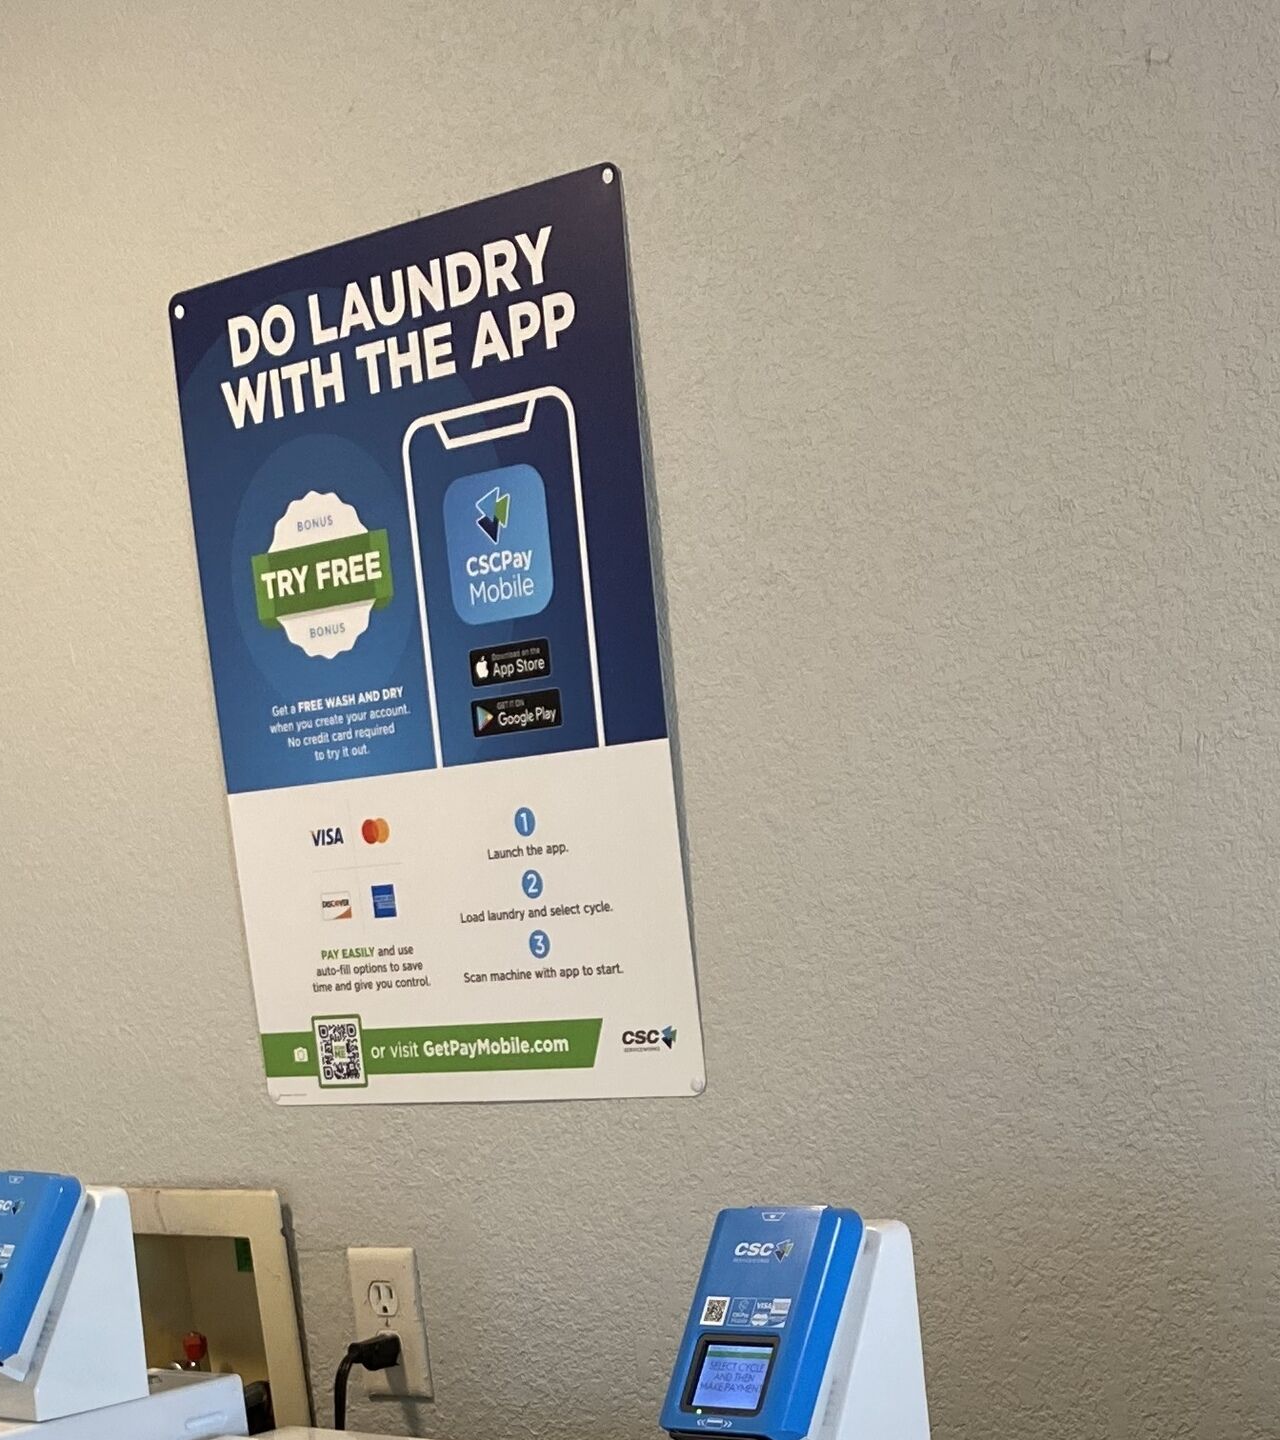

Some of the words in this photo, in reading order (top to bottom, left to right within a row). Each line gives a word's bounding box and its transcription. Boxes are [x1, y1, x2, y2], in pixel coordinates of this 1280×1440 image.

[227, 303, 296, 367] DO
[307, 225, 553, 346] LAUNDRY
[220, 352, 345, 430] WITH
[356, 321, 456, 394] THE
[471, 291, 575, 368] APP
[297, 515, 333, 532] BONUS
[466, 549, 533, 577] CSCPay
[260, 565, 308, 599] TRY
[316, 551, 382, 590] FREE
[469, 574, 535, 606] Mobile
[309, 622, 346, 638] BONUS
[493, 662, 515, 678] App
[516, 658, 545, 673] Store
[272, 705, 288, 717] Get
[298, 699, 323, 713] FREE
[324, 694, 356, 709] WASH
[358, 690, 380, 704] AND
[382, 686, 404, 700] DRY
[269, 722, 294, 734] when
[296, 719, 312, 732] you
[315, 714, 344, 728] create
[346, 711, 367, 725] your
[369, 704, 411, 719] account.
[498, 708, 534, 726] Google
[535, 706, 557, 722] Play
[287, 736, 301, 748] No
[303, 732, 330, 746] credit
[332, 728, 352, 741] card
[354, 722, 395, 739] required
[314, 750, 325, 760] to
[326, 748, 340, 760] try
[342, 746, 349, 757] it
[351, 744, 370, 756] out.
[520, 812, 528, 832] 1
[311, 827, 344, 847] VISA
[487, 846, 524, 860] Launch
[526, 844, 543, 856] the
[546, 843, 569, 855] app.
[526, 873, 539, 894] 2
[460, 911, 485, 924] Load
[487, 908, 525, 921] laundry
[528, 905, 548, 918] and
[550, 903, 581, 916] select
[583, 900, 613, 916] cycle.
[321, 949, 339, 960] PAY
[342, 946, 375, 959] EASILY
[378, 945, 395, 957] and
[398, 945, 414, 956] use
[533, 935, 546, 955] 3
[316, 964, 351, 976] auto-fill
[353, 962, 388, 976] options
[389, 962, 400, 972] to
[402, 962, 423, 972] save
[463, 972, 488, 984] Scan
[490, 969, 532, 982] machine
[534, 967, 557, 979] with
[559, 967, 580, 980] app
[582, 965, 594, 976] to
[596, 962, 624, 976] start.
[312, 982, 332, 993] time
[335, 980, 352, 992] and
[354, 980, 373, 992] give
[376, 980, 393, 990] you
[395, 976, 431, 988] control.
[622, 1030, 660, 1045] CSC
[370, 1045, 387, 1059] or
[390, 1042, 419, 1059] visit
[423, 1036, 569, 1061] GetPayMobile.com
[734, 1242, 774, 1256] CSC
[709, 1362, 738, 1371] SELECT
[739, 1362, 766, 1372] CYCLE
